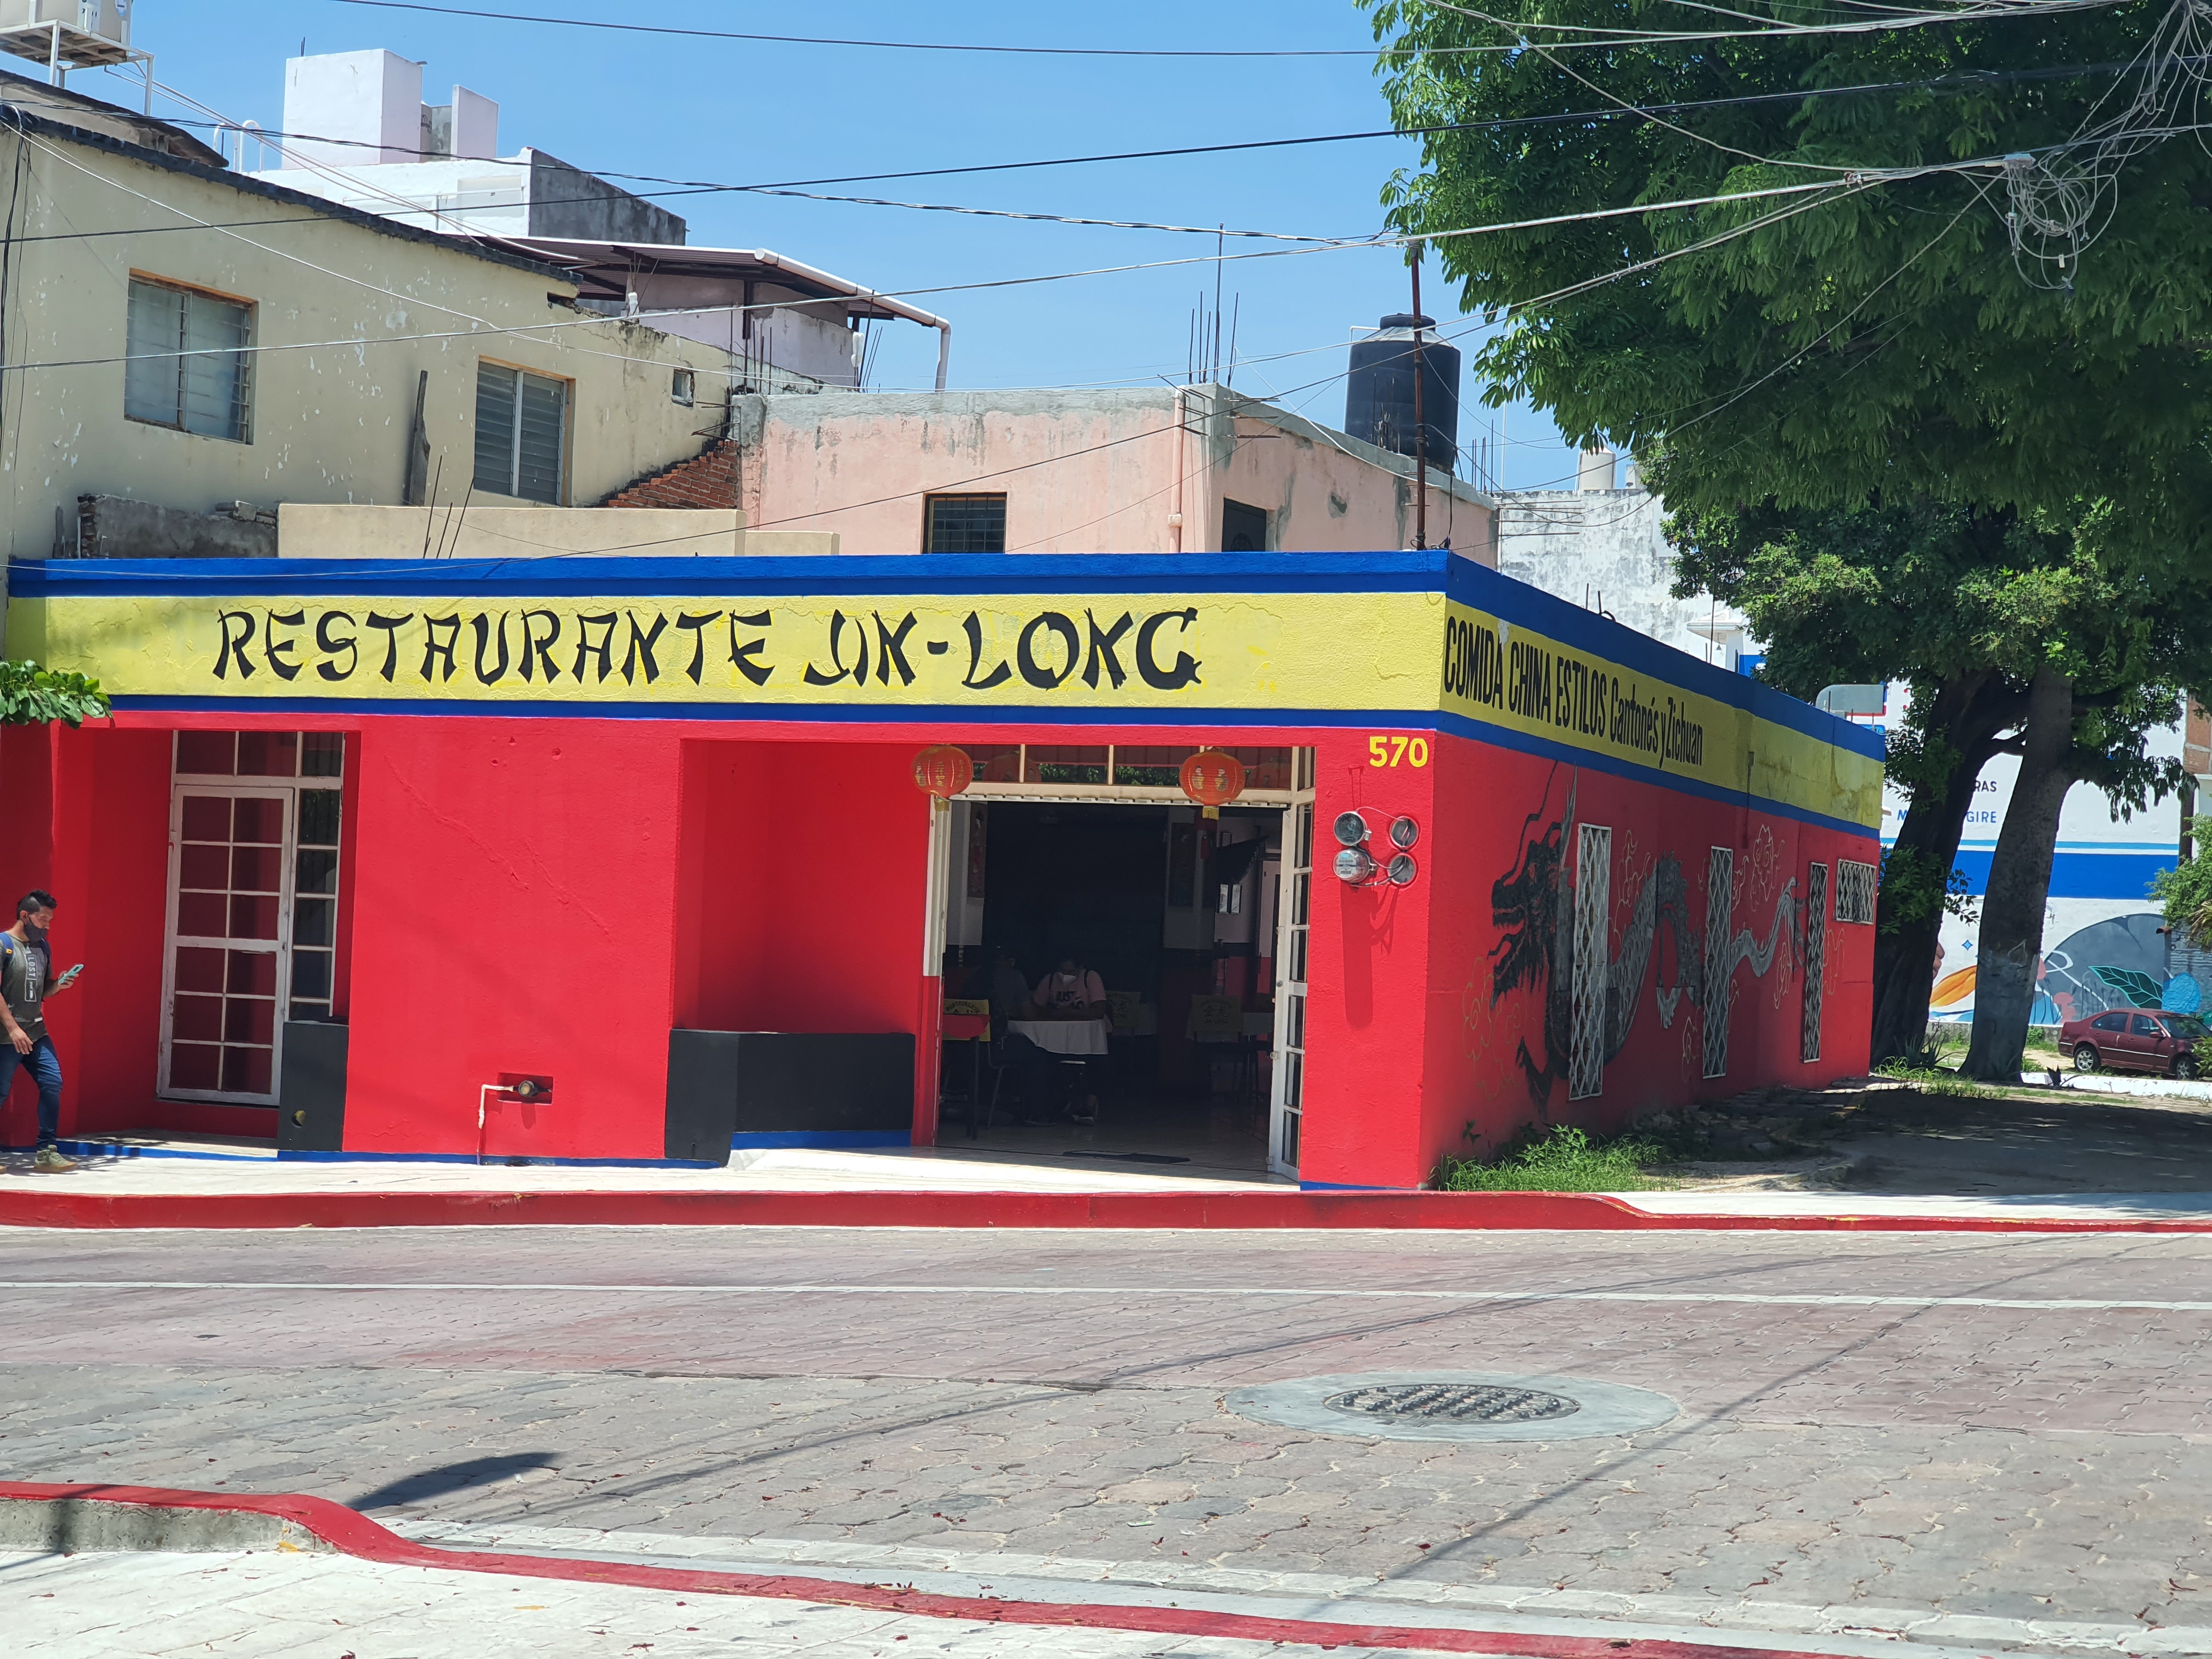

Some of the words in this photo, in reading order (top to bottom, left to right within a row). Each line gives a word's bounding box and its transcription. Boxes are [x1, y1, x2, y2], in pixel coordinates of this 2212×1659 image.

[213, 608, 776, 686] RESTAURANTE
[803, 607, 1202, 691] JIN-LONG
[1444, 616, 1503, 709] COMIDA
[1509, 641, 1551, 723] CHINA
[1555, 656, 1606, 737] ESTILOS
[1610, 677, 1658, 753] Cantonés
[1659, 712, 1666, 769] y
[1666, 697, 1703, 766] Zichuan
[1369, 736, 1428, 768] 570
[27, 957, 36, 977] LOST
